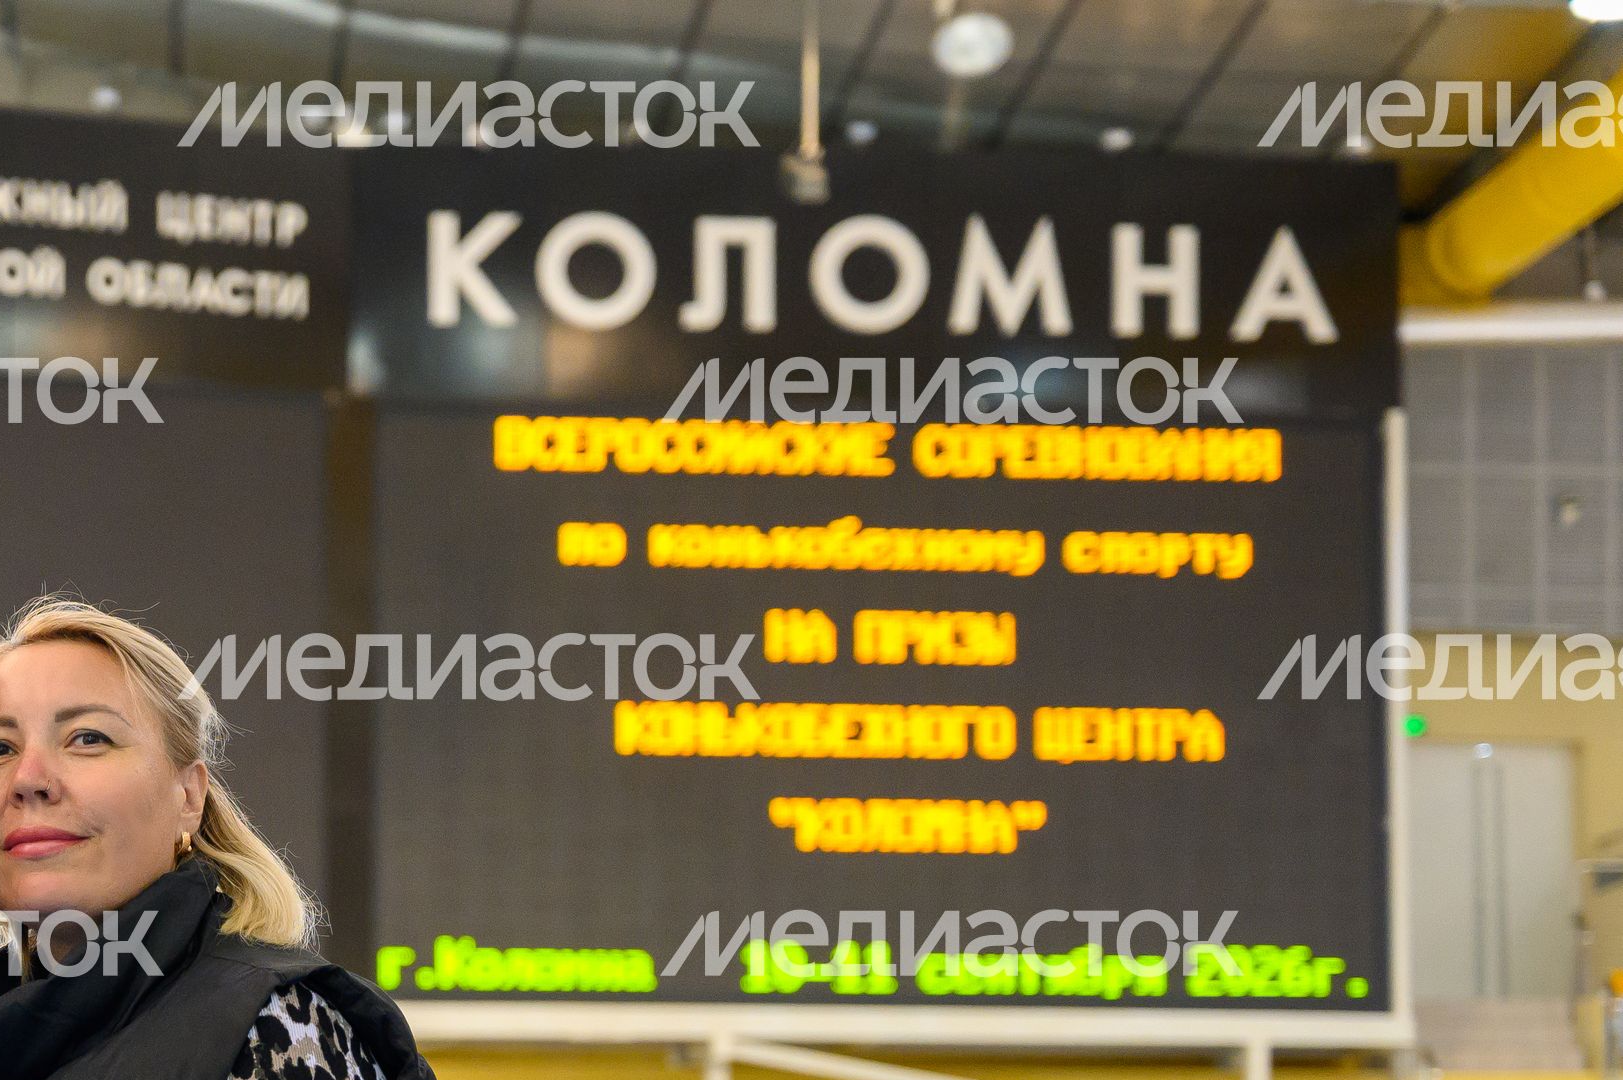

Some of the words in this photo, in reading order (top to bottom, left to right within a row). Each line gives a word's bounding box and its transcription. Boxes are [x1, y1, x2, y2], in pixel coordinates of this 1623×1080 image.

[156, 192, 308, 247] ЦЕНТР
[86, 257, 310, 320] ОБЛАСТИ
[427, 210, 1338, 344] КОЛОМНА
[912, 423, 1283, 482] СОРЕВНОВАНИЯ
[557, 522, 627, 567] по
[647, 515, 1046, 577] конькобежному
[1062, 531, 1254, 579] спорту
[764, 608, 838, 664] НА
[853, 609, 1017, 666] ПРИЗЫ
[614, 699, 1017, 760] КОНЬКОБЕЖНОГО
[1033, 706, 1226, 764] ЦЕНТРА
[915, 945, 1169, 1000] сентября
